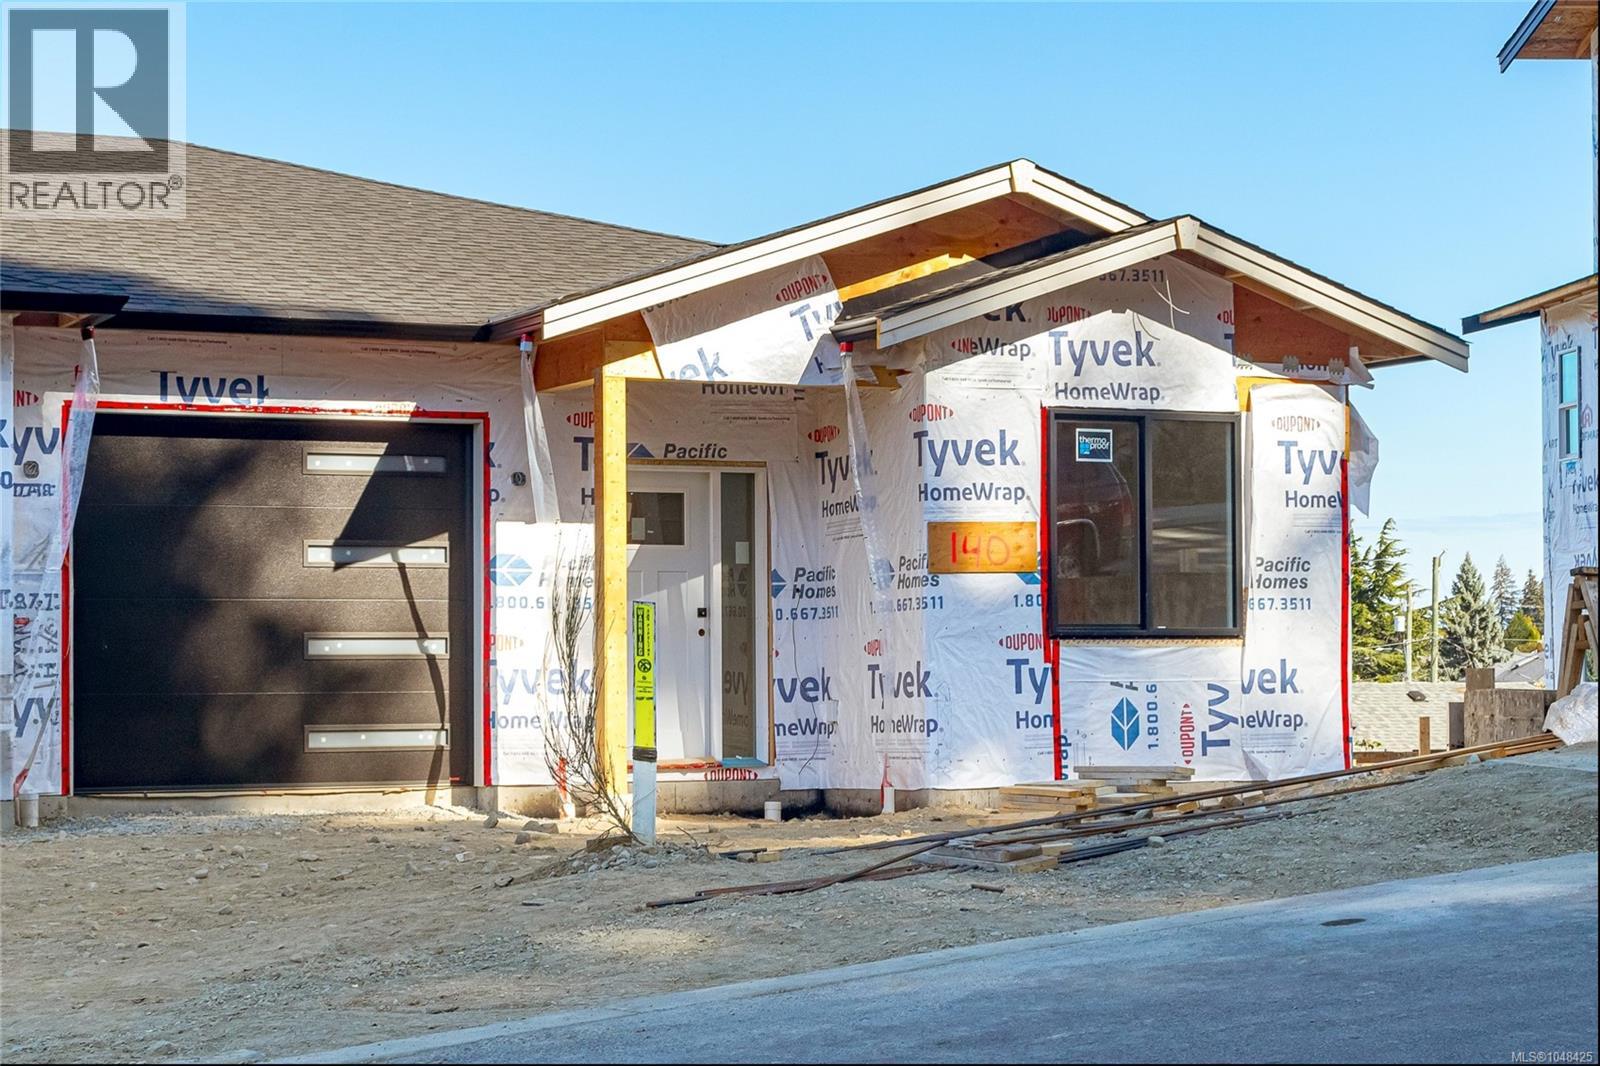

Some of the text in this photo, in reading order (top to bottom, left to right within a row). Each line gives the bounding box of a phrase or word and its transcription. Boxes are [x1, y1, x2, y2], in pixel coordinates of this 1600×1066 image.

[780, 274, 822, 302] DUPONT
[1048, 330, 1154, 377] Tyvek
[1055, 382, 1161, 404] HomeWrap
[1276, 416, 1316, 432] DUPONT
[664, 443, 728, 459] Pacific
[913, 429, 1021, 477] Tyvek
[918, 482, 1026, 505] HomeWrap
[951, 531, 1010, 568] 140
[794, 565, 836, 583] Pacific
[1256, 557, 1311, 572] Pacific
[791, 583, 837, 600] Homes
[897, 573, 940, 590] Homes
[1180, 710, 1195, 757] DUPONT
